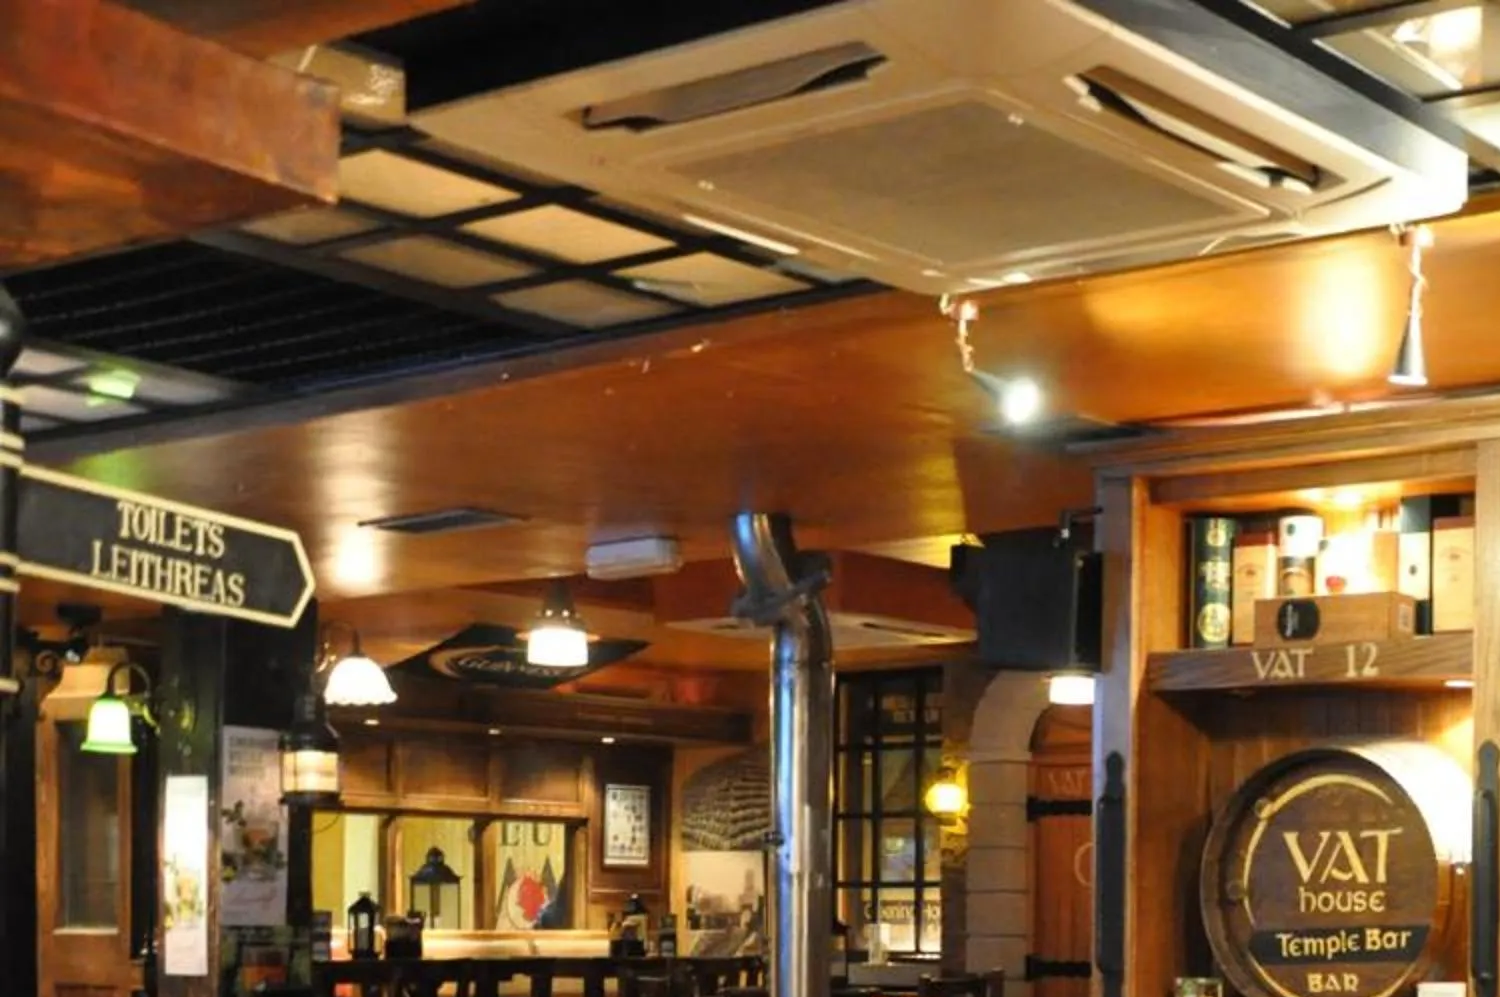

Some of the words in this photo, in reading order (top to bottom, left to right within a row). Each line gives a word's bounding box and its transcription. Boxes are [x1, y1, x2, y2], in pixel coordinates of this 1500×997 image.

[117, 501, 226, 558] TOILETS
[91, 539, 246, 607] LEITHREAS
[1251, 647, 1314, 679] VAT
[1345, 642, 1380, 678] 12
[1282, 827, 1404, 885] VAT
[1275, 929, 1361, 960] Temple
[1364, 927, 1412, 950] Bar
[1307, 972, 1360, 993] BAR
